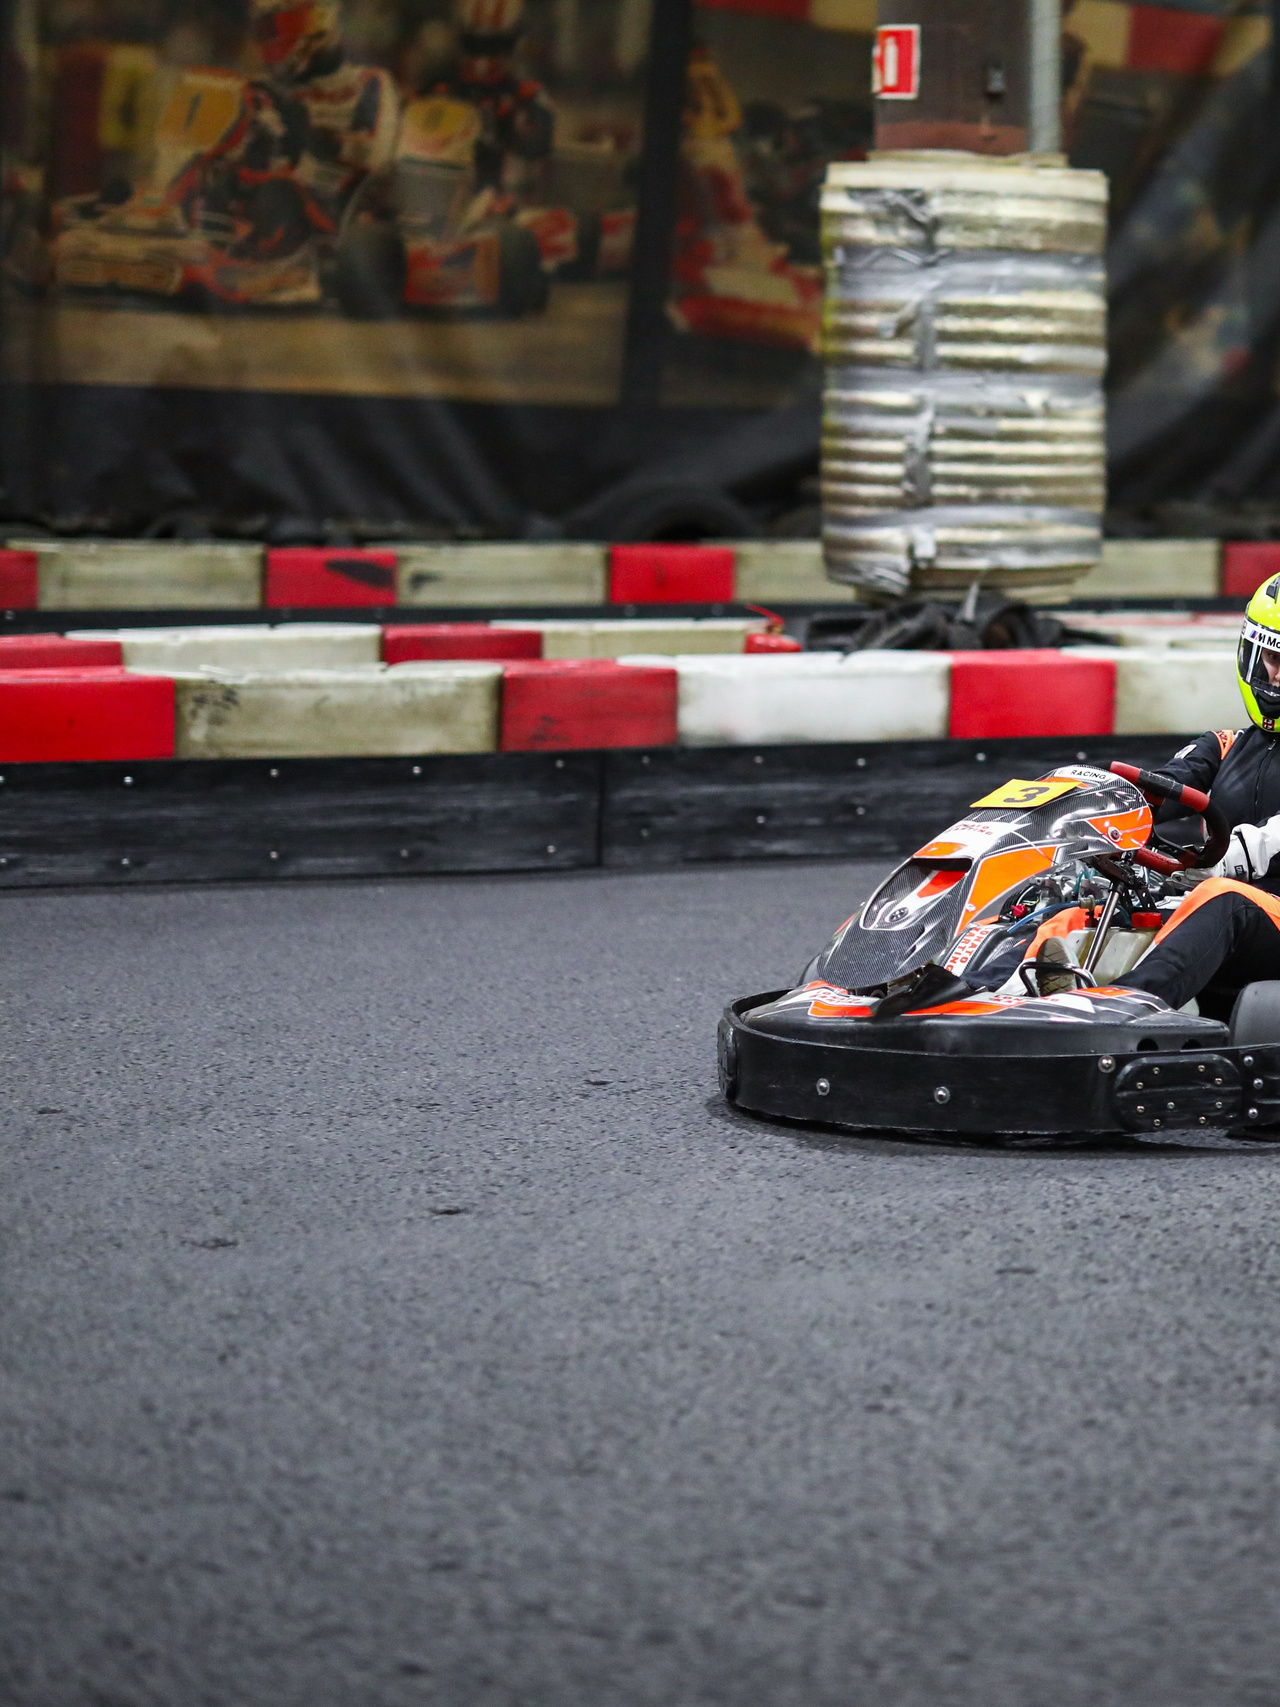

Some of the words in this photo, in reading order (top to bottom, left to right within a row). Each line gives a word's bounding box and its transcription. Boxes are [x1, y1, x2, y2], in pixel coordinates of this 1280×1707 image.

[1070, 769, 1107, 779] RACING
[1003, 786, 1050, 803] 3
[960, 928, 990, 964] ONATO
